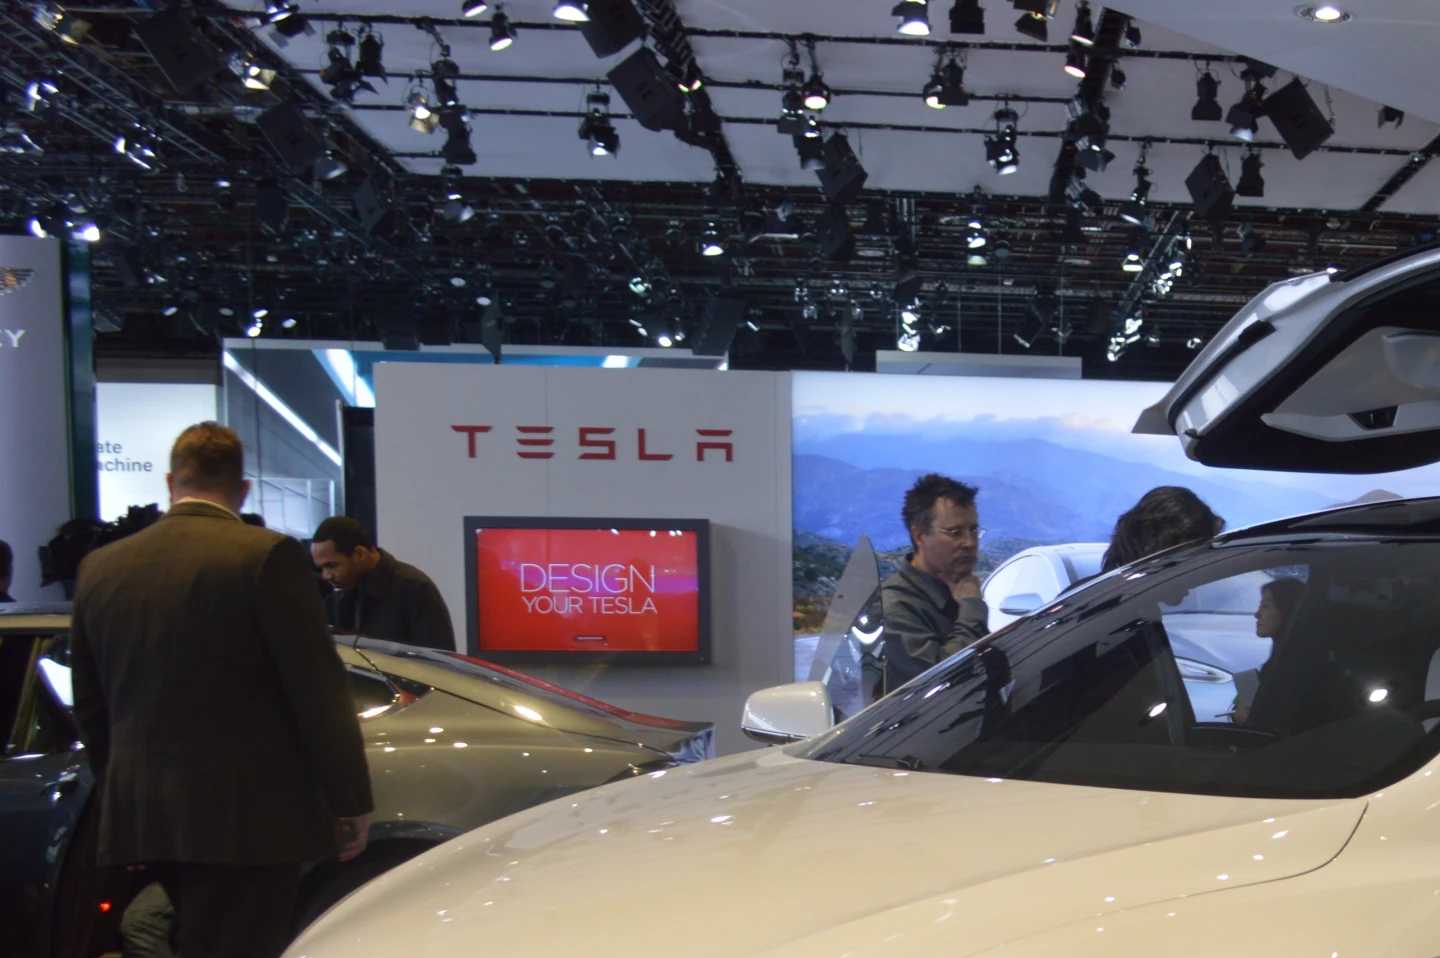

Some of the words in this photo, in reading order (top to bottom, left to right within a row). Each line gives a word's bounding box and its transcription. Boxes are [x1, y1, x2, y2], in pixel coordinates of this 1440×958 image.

[450, 424, 733, 463] TESLA
[520, 563, 656, 594] DESIGN
[522, 595, 584, 614] YOUR
[588, 596, 658, 615] TESLA
